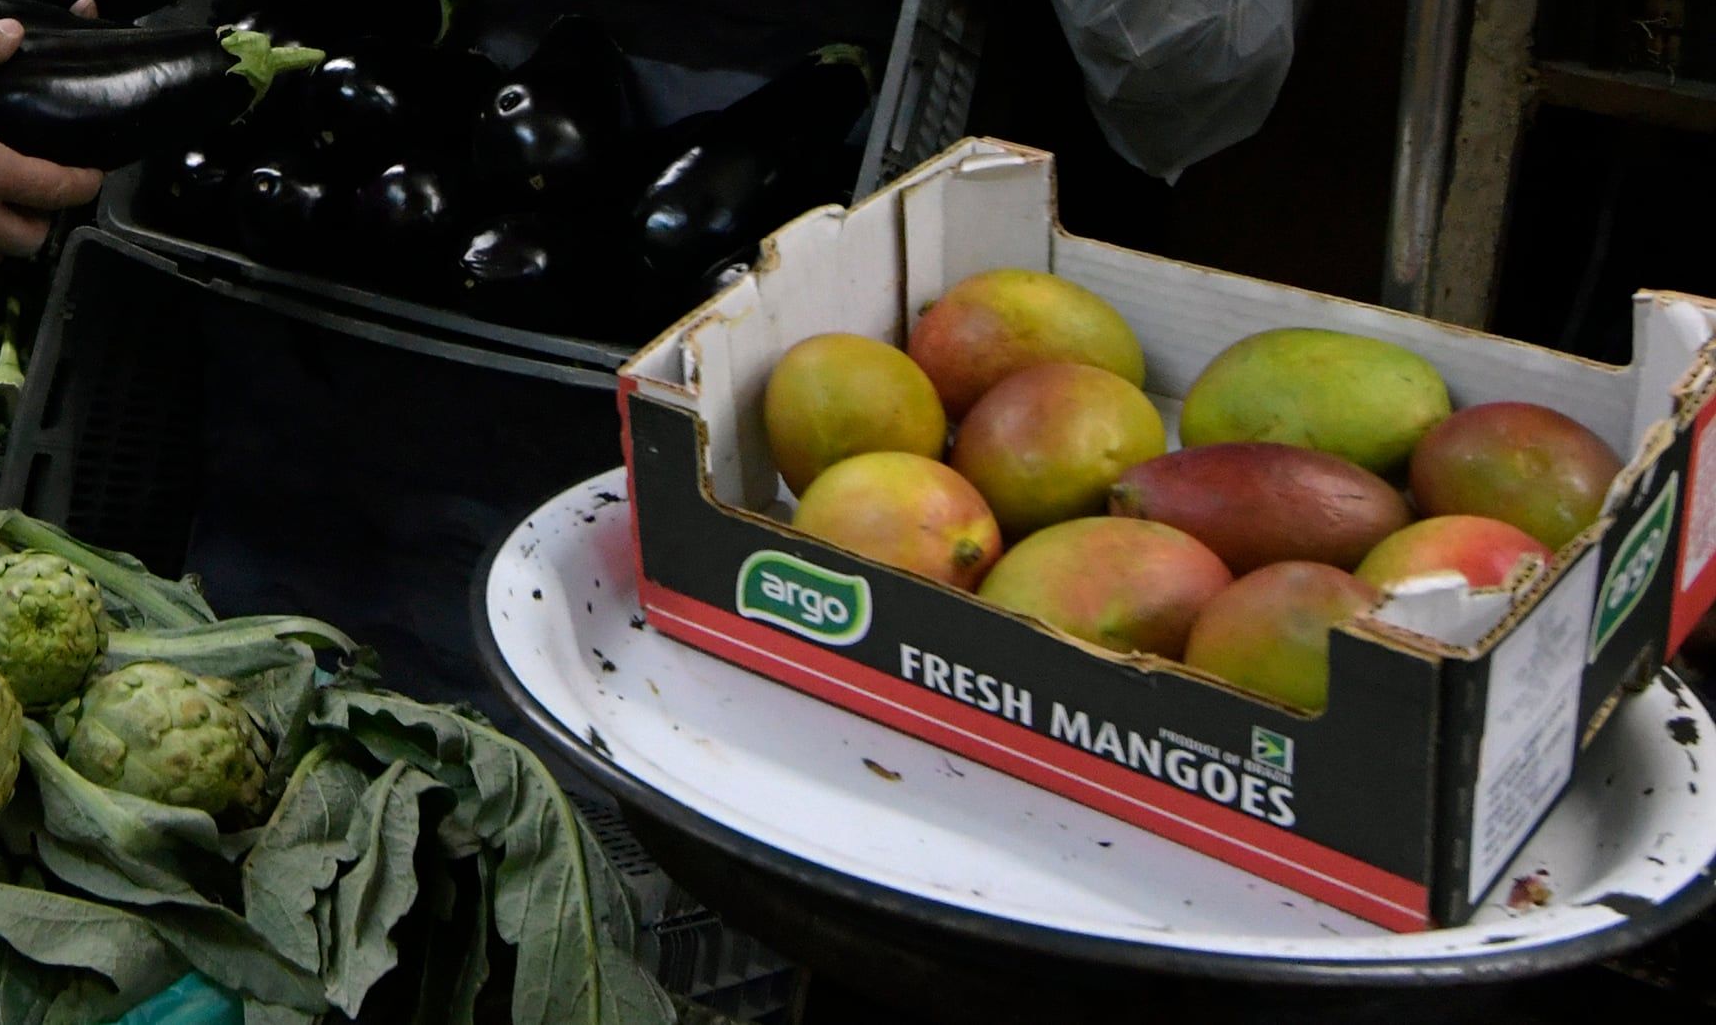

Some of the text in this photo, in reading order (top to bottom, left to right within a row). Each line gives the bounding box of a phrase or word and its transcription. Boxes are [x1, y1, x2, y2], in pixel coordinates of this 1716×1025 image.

[759, 570, 850, 625] argo
[900, 643, 1297, 828] FRESH MANGOES
